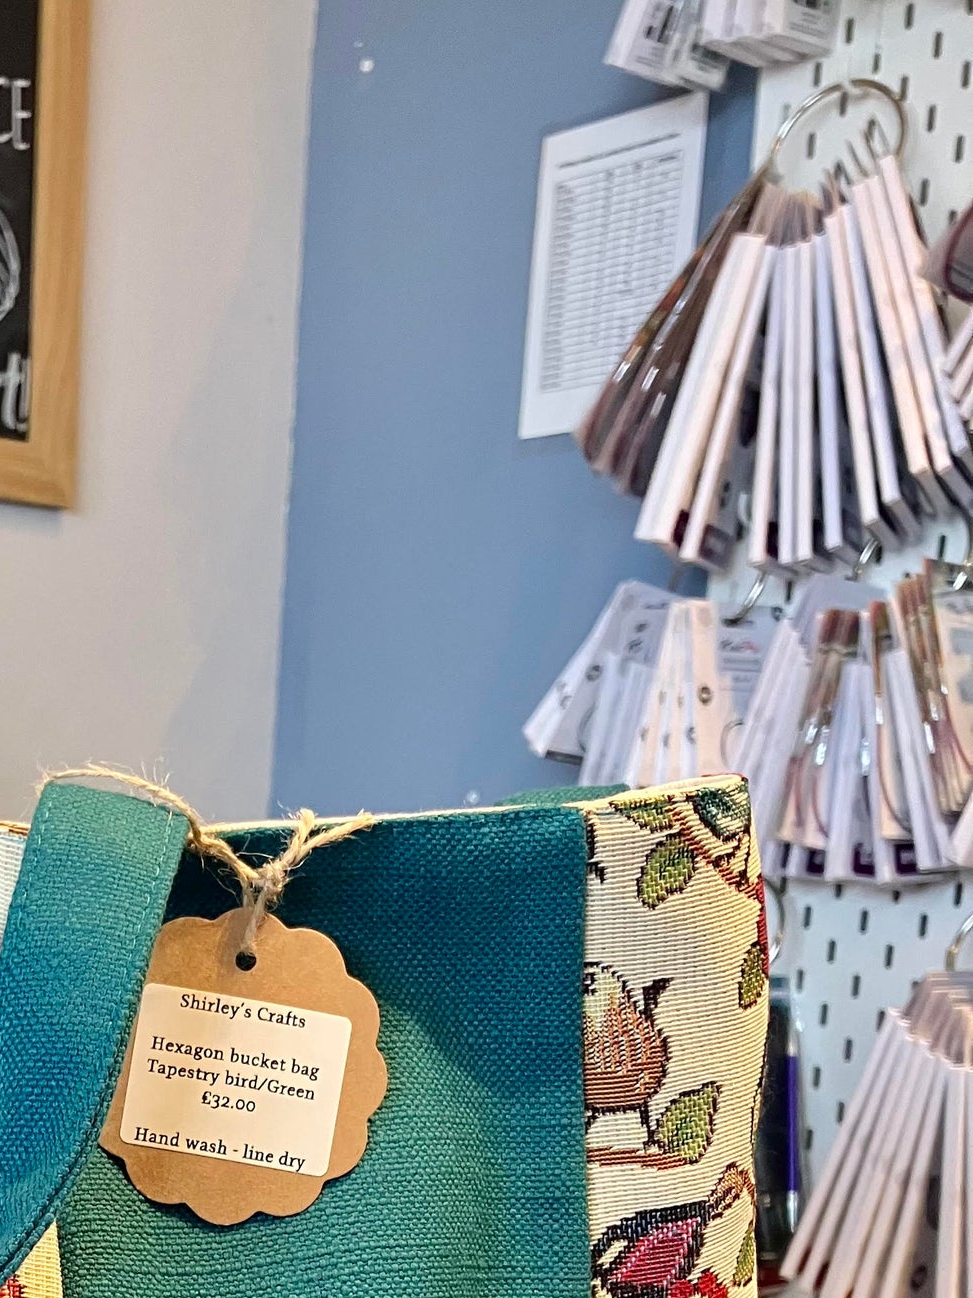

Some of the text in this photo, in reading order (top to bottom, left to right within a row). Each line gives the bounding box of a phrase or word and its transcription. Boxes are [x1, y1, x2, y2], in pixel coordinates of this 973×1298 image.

[180, 993, 307, 1028] Shirley's Crafts
[147, 1058, 315, 1100] Tapestry bird/Green
[150, 1035, 321, 1081] Hexagon bucket bag
[201, 1090, 257, 1113] £32.00
[134, 1126, 180, 1148] Hand
[185, 1138, 228, 1156] wash
[242, 1143, 274, 1163] line
[278, 1151, 306, 1172] dry
